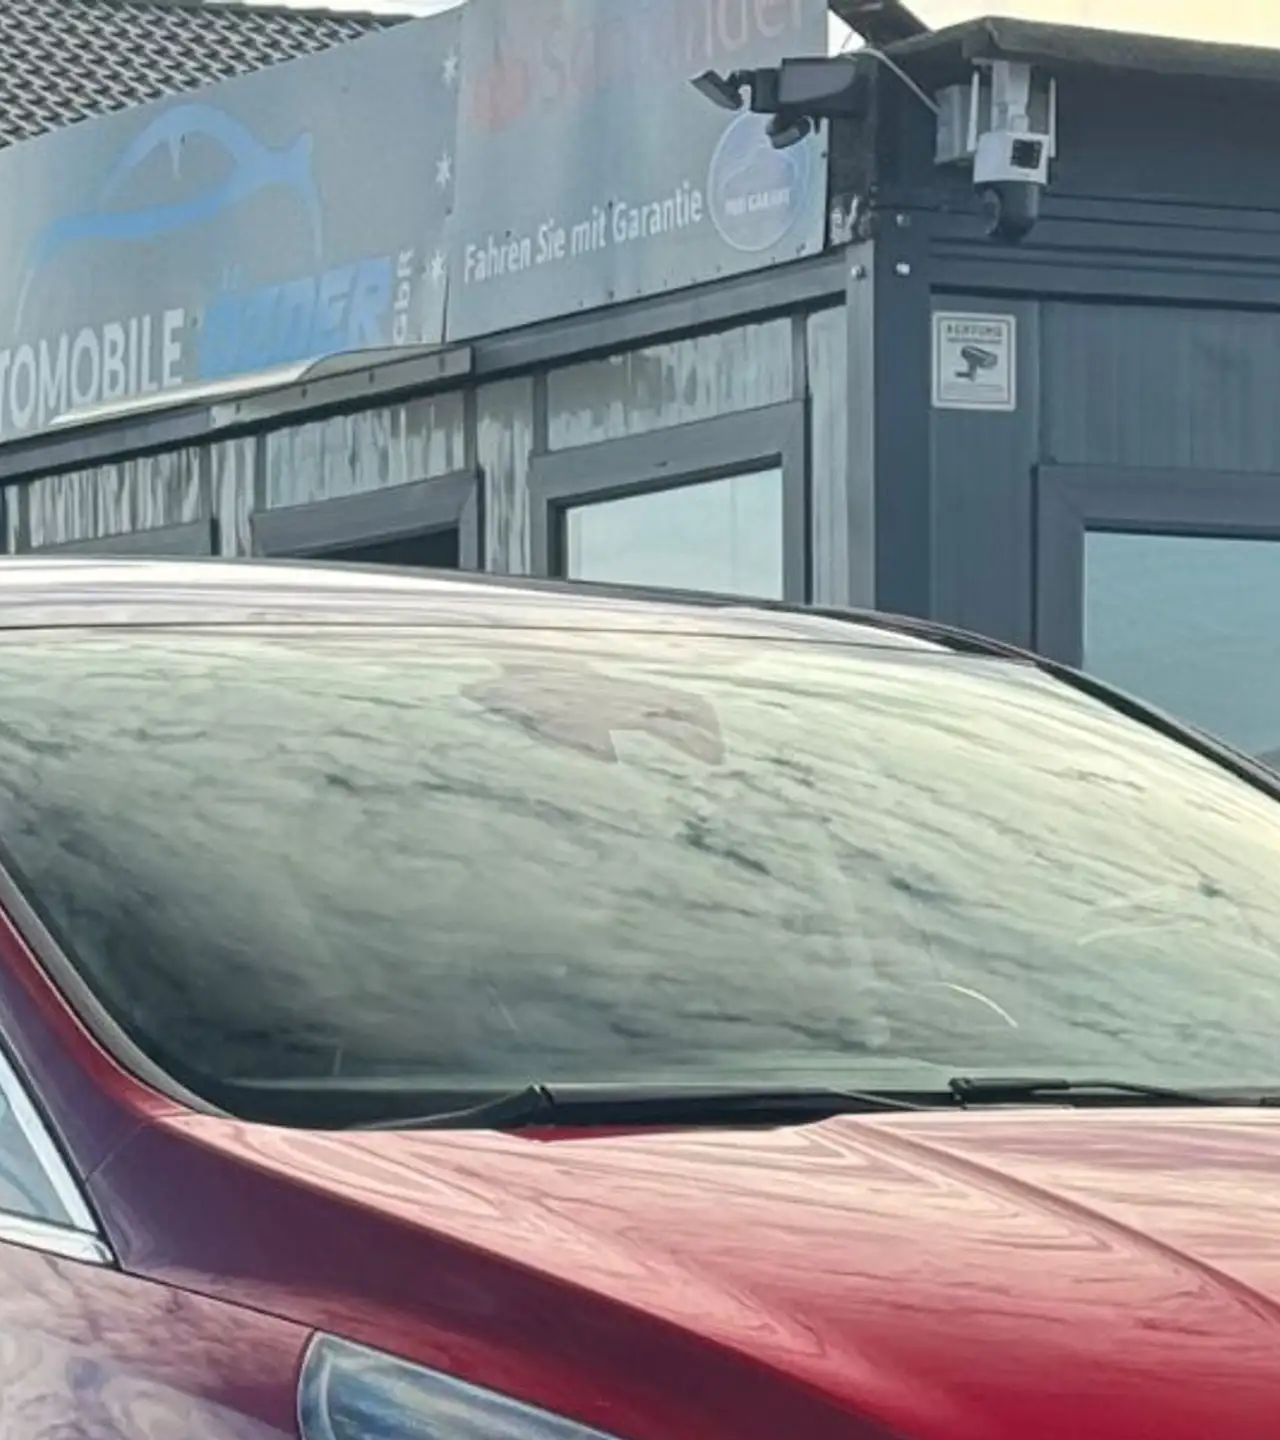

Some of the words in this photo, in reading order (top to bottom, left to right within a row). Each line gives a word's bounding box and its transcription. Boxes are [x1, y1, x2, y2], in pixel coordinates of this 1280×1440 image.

[464, 213, 532, 284] Fahren
[536, 217, 566, 264] Sie
[571, 206, 607, 256] mit
[612, 181, 703, 244] Garantie
[392, 248, 414, 346] GbR
